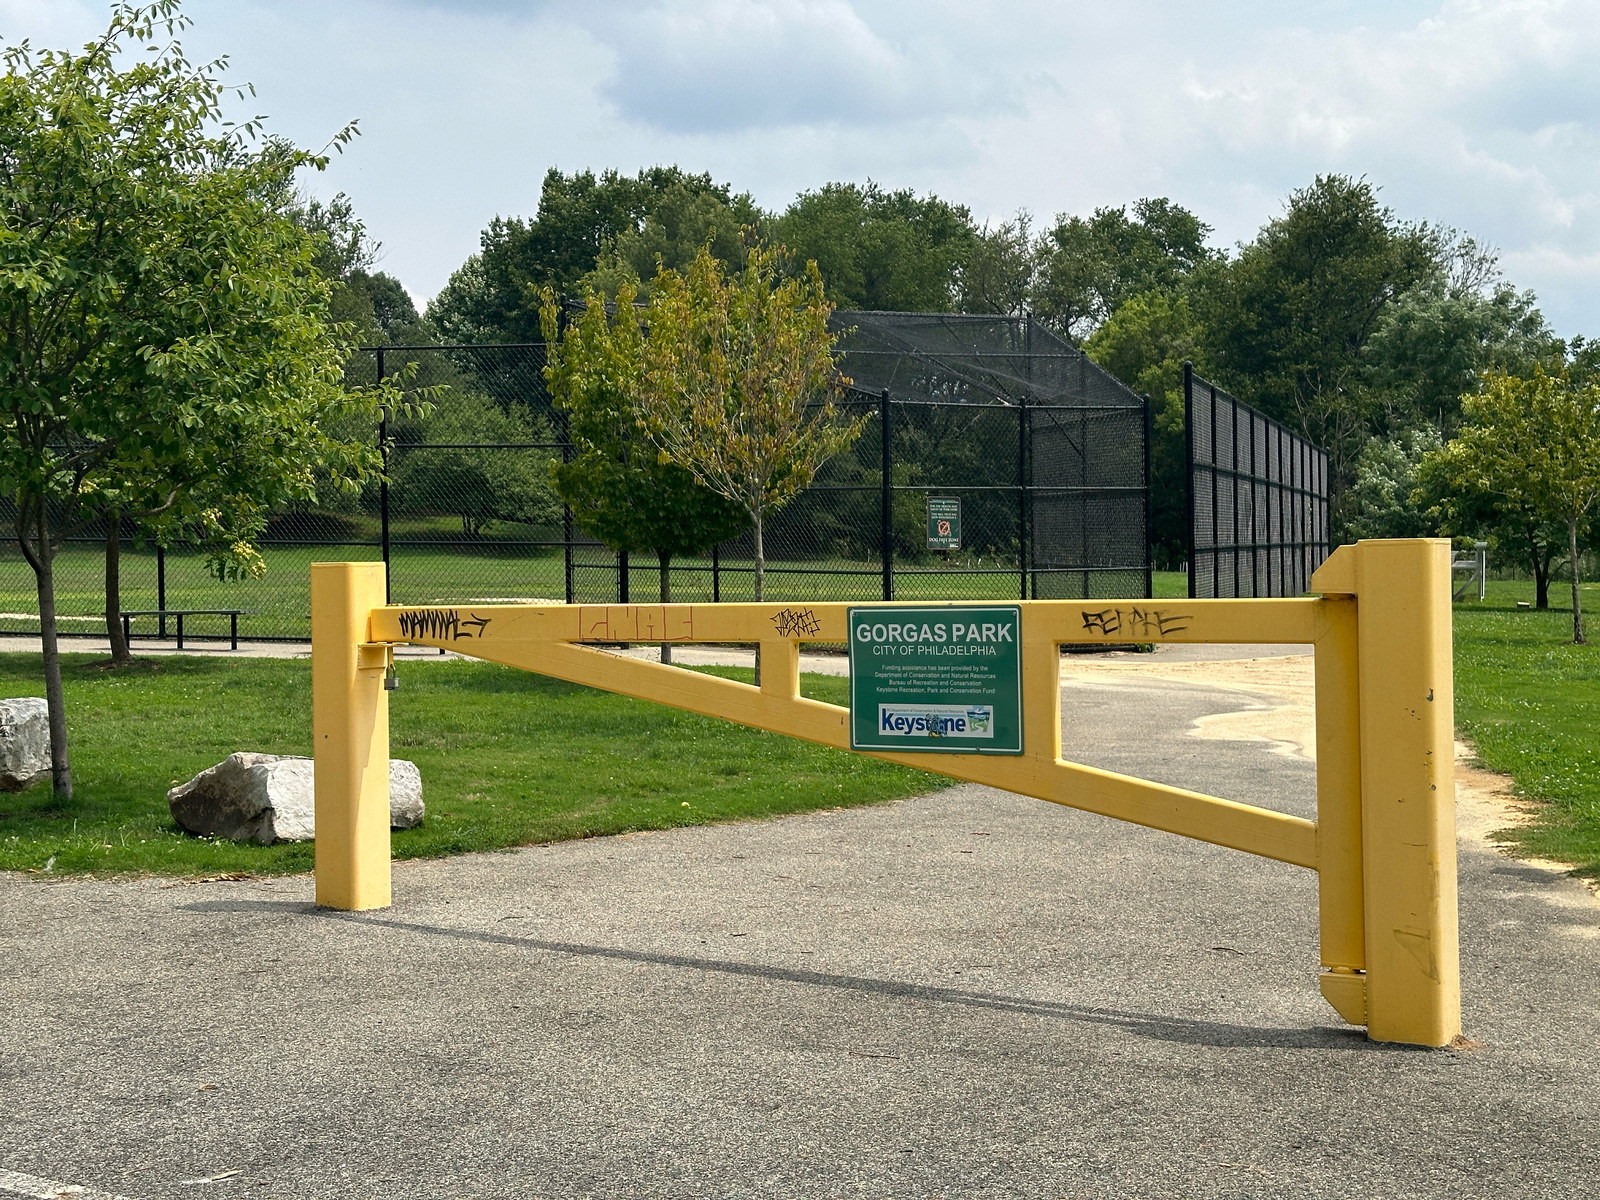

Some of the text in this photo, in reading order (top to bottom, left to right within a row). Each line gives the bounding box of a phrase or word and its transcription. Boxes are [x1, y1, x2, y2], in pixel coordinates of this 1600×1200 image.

[856, 624, 1012, 642] GORGAS PARK
[873, 646, 997, 656] CITY OF PHILADELPHIA
[882, 708, 966, 734] Keystne
